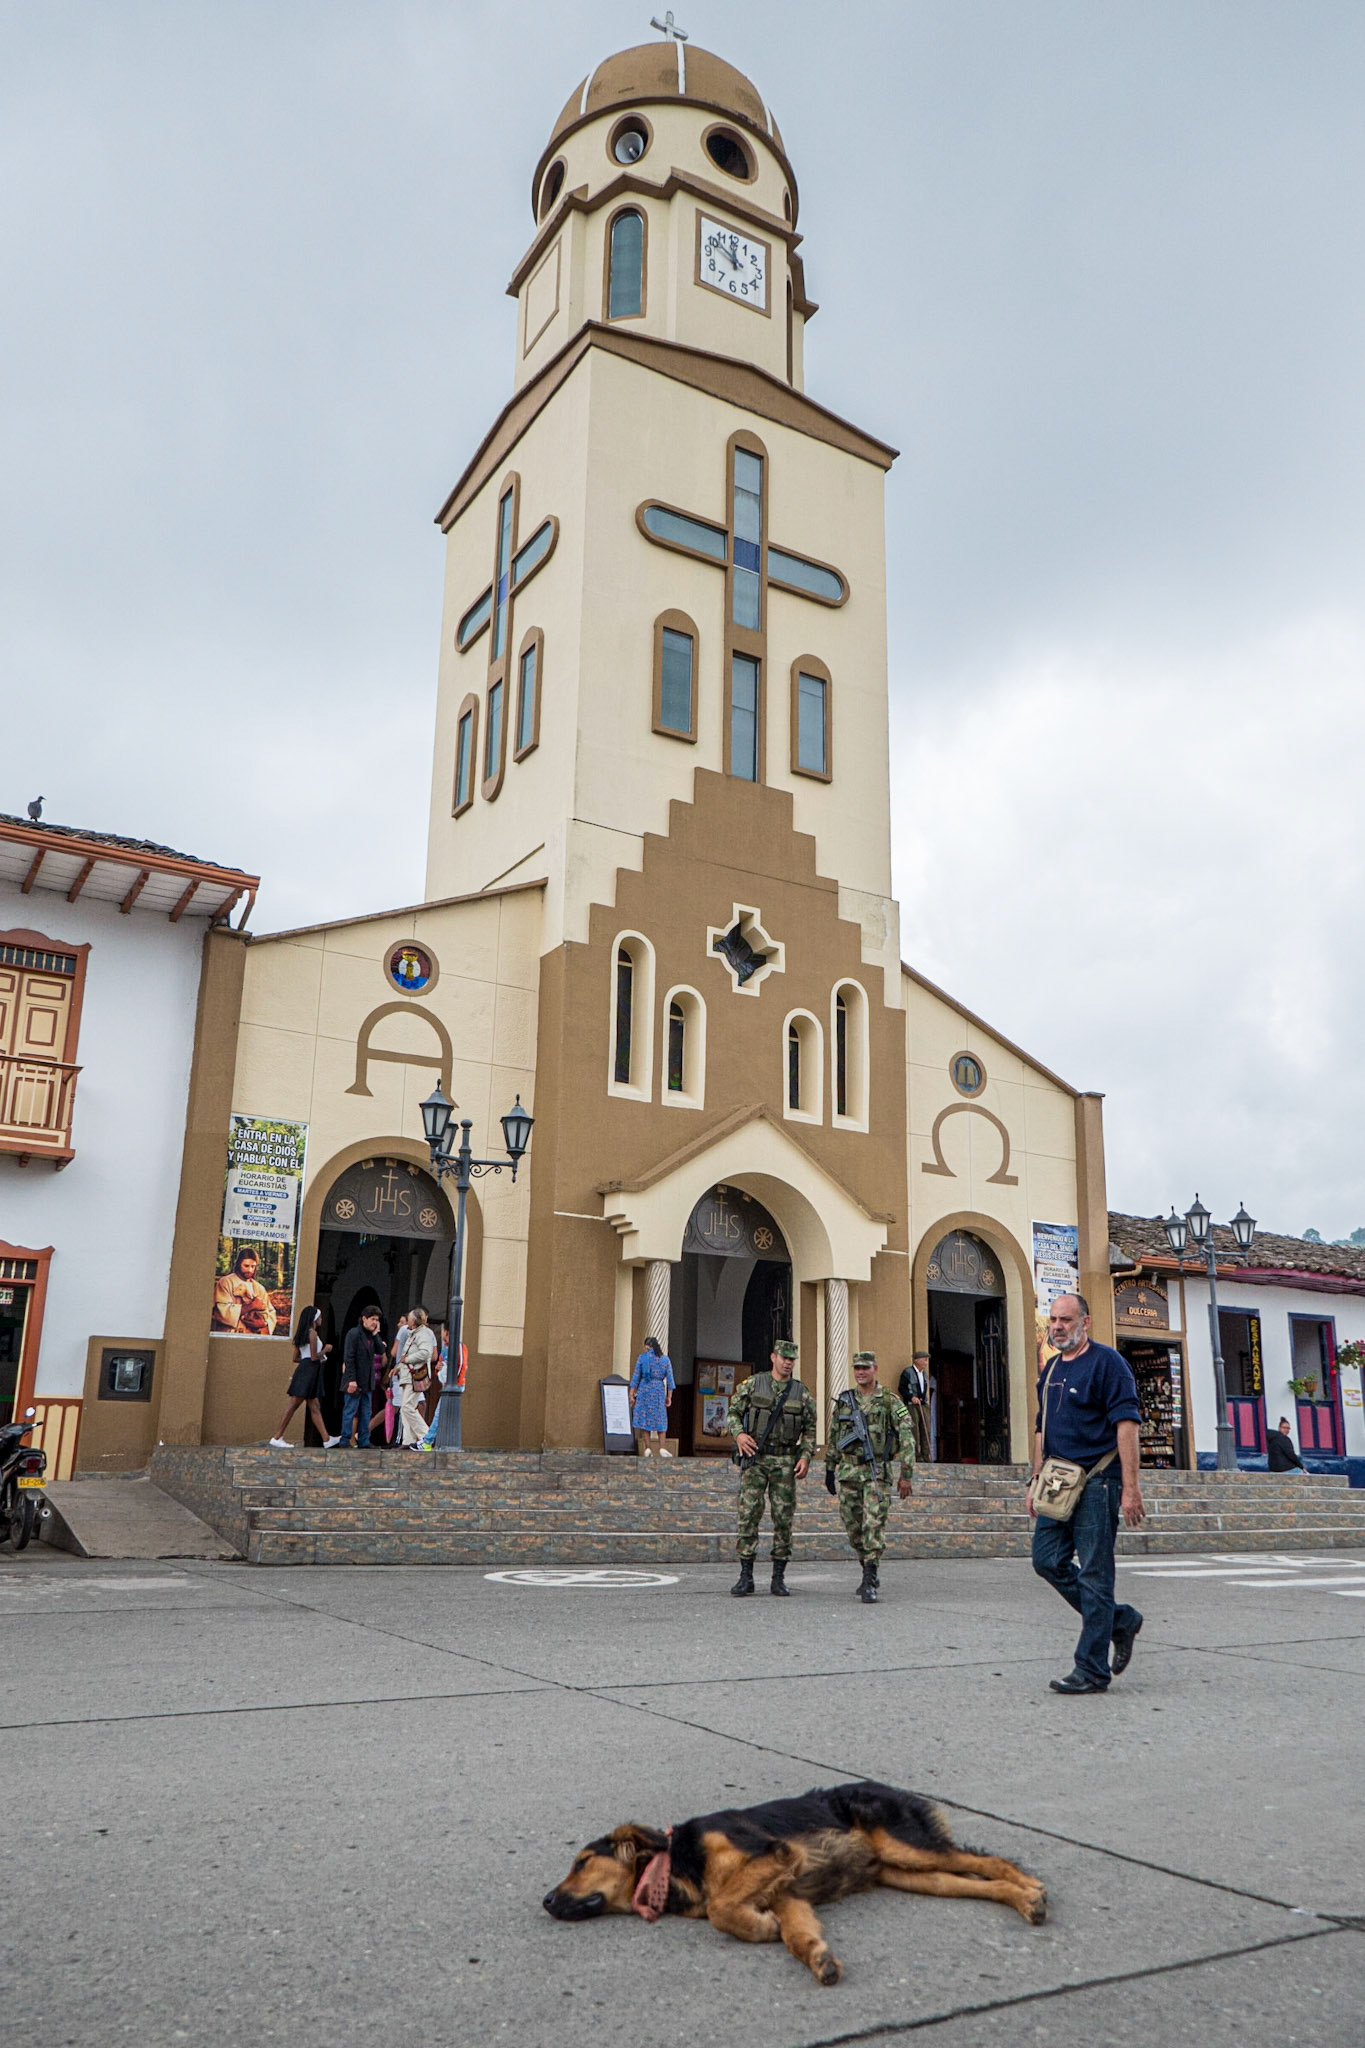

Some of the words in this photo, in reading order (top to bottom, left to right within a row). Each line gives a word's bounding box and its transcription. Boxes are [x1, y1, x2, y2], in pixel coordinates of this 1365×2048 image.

[717, 232, 726, 244] 11
[704, 245, 712, 257] 9
[742, 244, 747, 256] 1
[708, 259, 716, 271] 8
[750, 255, 758, 266] 2
[718, 271, 725, 282] 7
[755, 268, 762, 280] 3
[729, 280, 736, 292] 6
[741, 283, 748, 295] 5
[749, 279, 759, 291] 4
[238, 1129, 267, 1141] ENTRA
[270, 1133, 282, 1142] EN
[284, 1135, 295, 1144] LA
[234, 1140, 258, 1152] CASA
[261, 1144, 273, 1153] DE
[276, 1146, 296, 1156] DIOS
[228, 1151, 234, 1160] Y
[237, 1153, 266, 1165] HABLA
[269, 1157, 287, 1168] CON
[241, 1173, 274, 1182] HORARIO
[242, 1229, 287, 1239] ESPERAMOS!
[1115, 1279, 1136, 1296] CENTRO
[1250, 1320, 1261, 1390] RESTAURANTE
